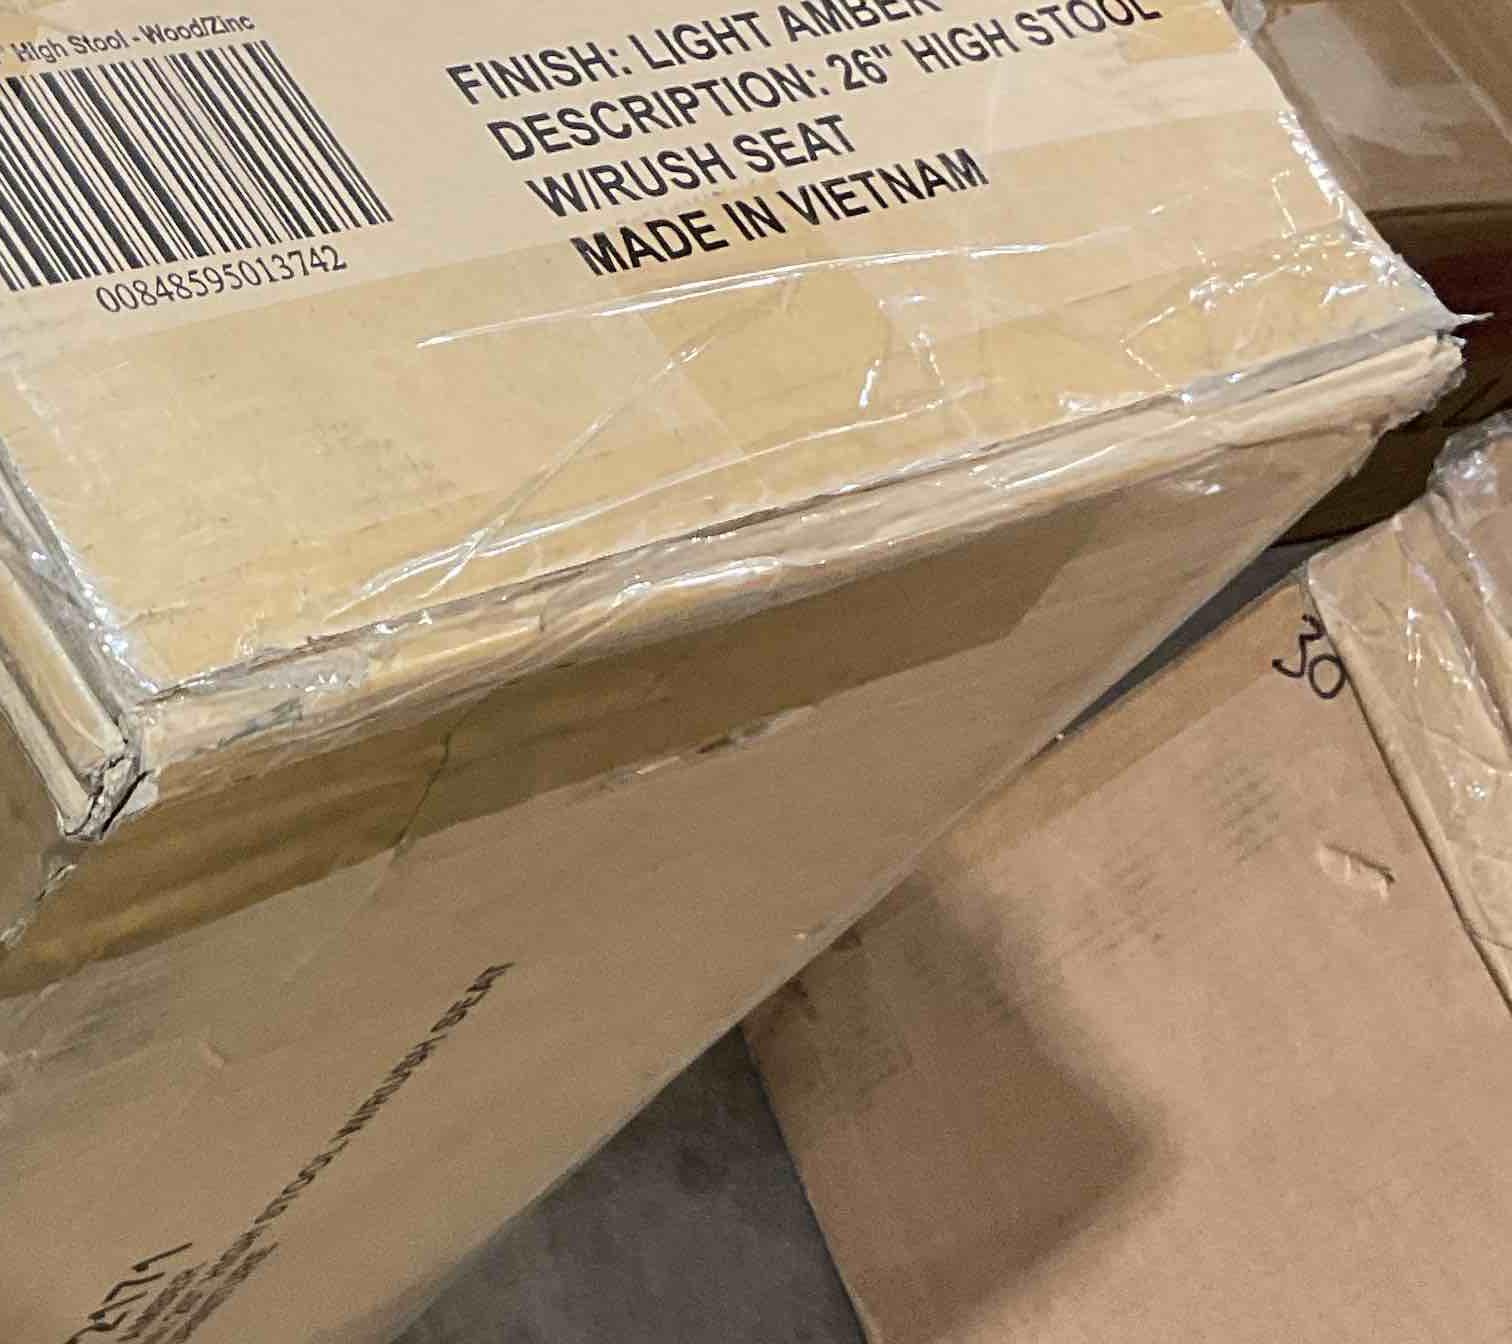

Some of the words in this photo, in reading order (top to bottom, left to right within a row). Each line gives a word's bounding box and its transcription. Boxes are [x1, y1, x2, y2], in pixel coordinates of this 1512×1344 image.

[67, 28, 131, 55] Stool
[445, 41, 634, 105] FINISH:
[626, 10, 773, 71] LIGHT
[486, 62, 831, 162] DESCRIPTION:
[825, 43, 894, 92] 26"
[901, 18, 1022, 74] HIGH
[524, 141, 738, 219] W/RUSH
[732, 113, 856, 175] SEAT
[569, 208, 731, 278] MADE
[720, 195, 788, 242] IN
[775, 147, 991, 227] VIETNAM
[94, 244, 348, 315] 00848595013742
